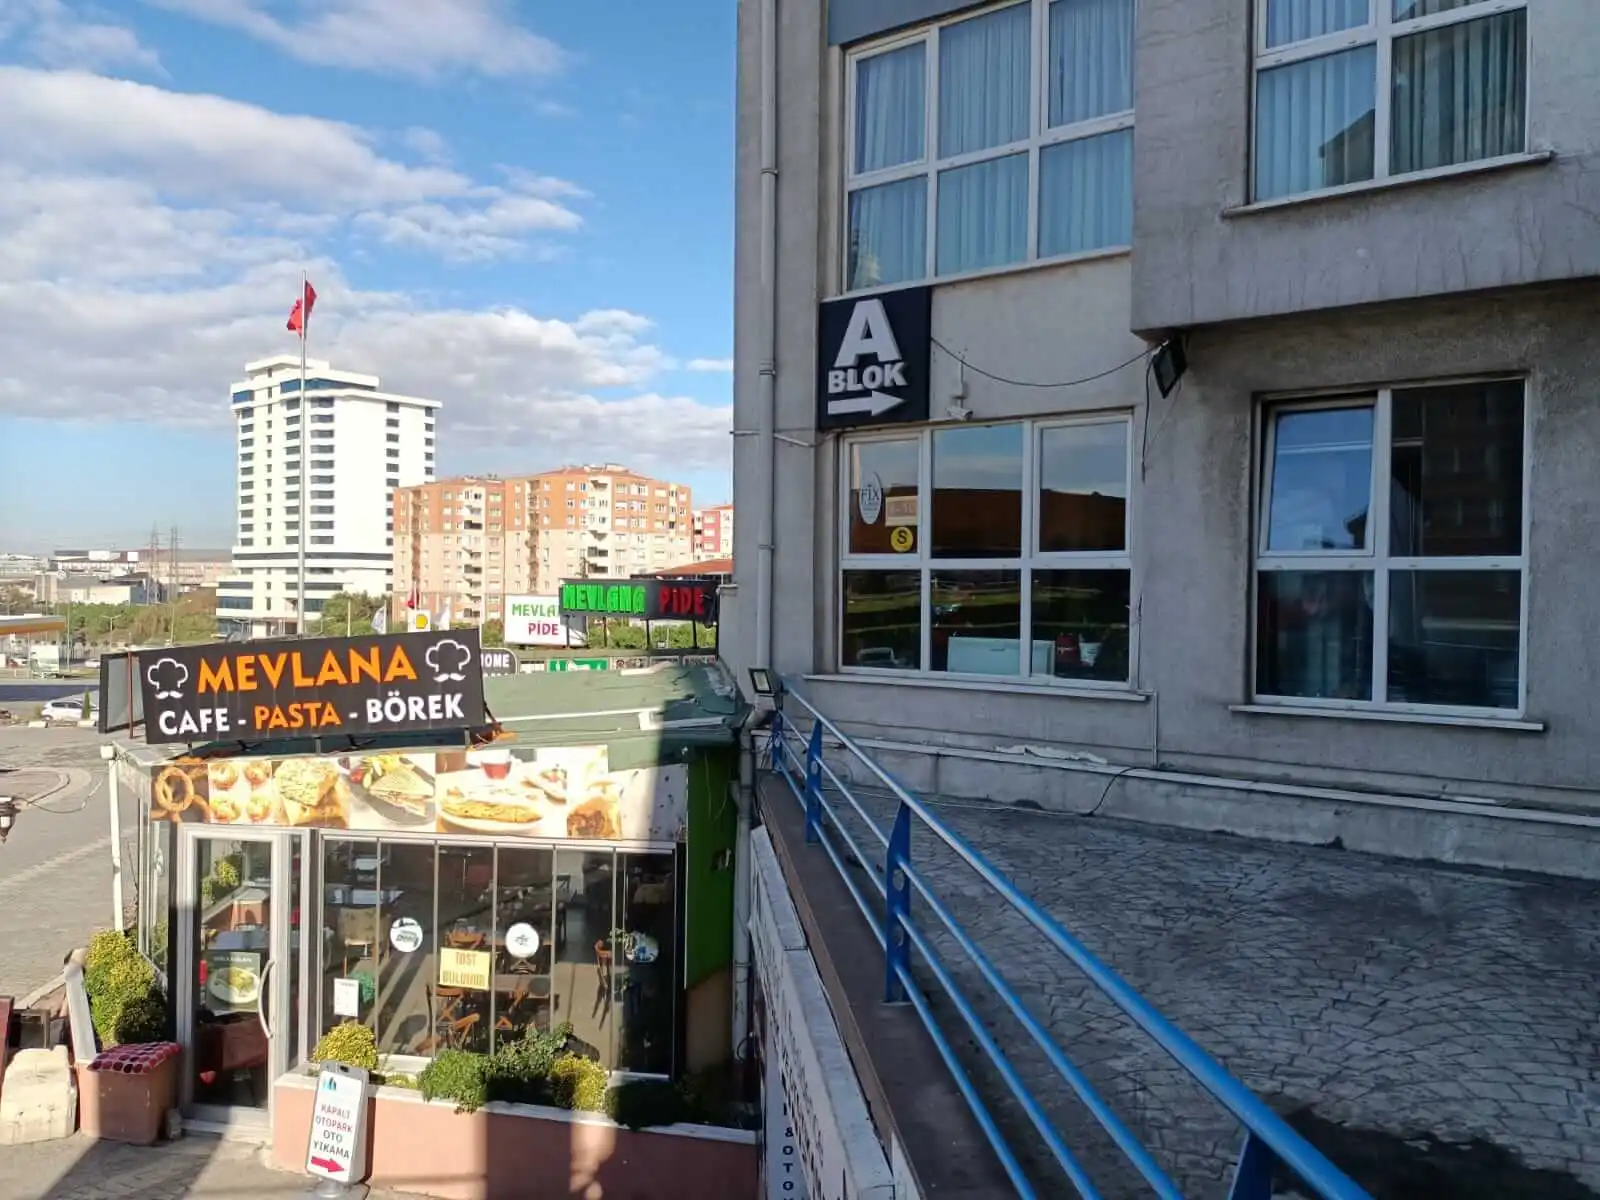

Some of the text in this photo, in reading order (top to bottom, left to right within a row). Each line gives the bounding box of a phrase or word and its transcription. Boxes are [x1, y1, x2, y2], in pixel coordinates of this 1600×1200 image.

[834, 299, 902, 367] A
[828, 362, 908, 394] BLOK
[897, 528, 909, 545] S
[511, 602, 558, 617] MEVLA
[198, 645, 418, 694] MEVLANA
[158, 707, 231, 736] CAFE
[254, 701, 342, 730] PASTA
[366, 690, 465, 723] BÖREK
[315, 1116, 352, 1132] OTOPARK
[323, 1130, 343, 1143] OTO
[313, 1141, 349, 1158] YIKAMA
